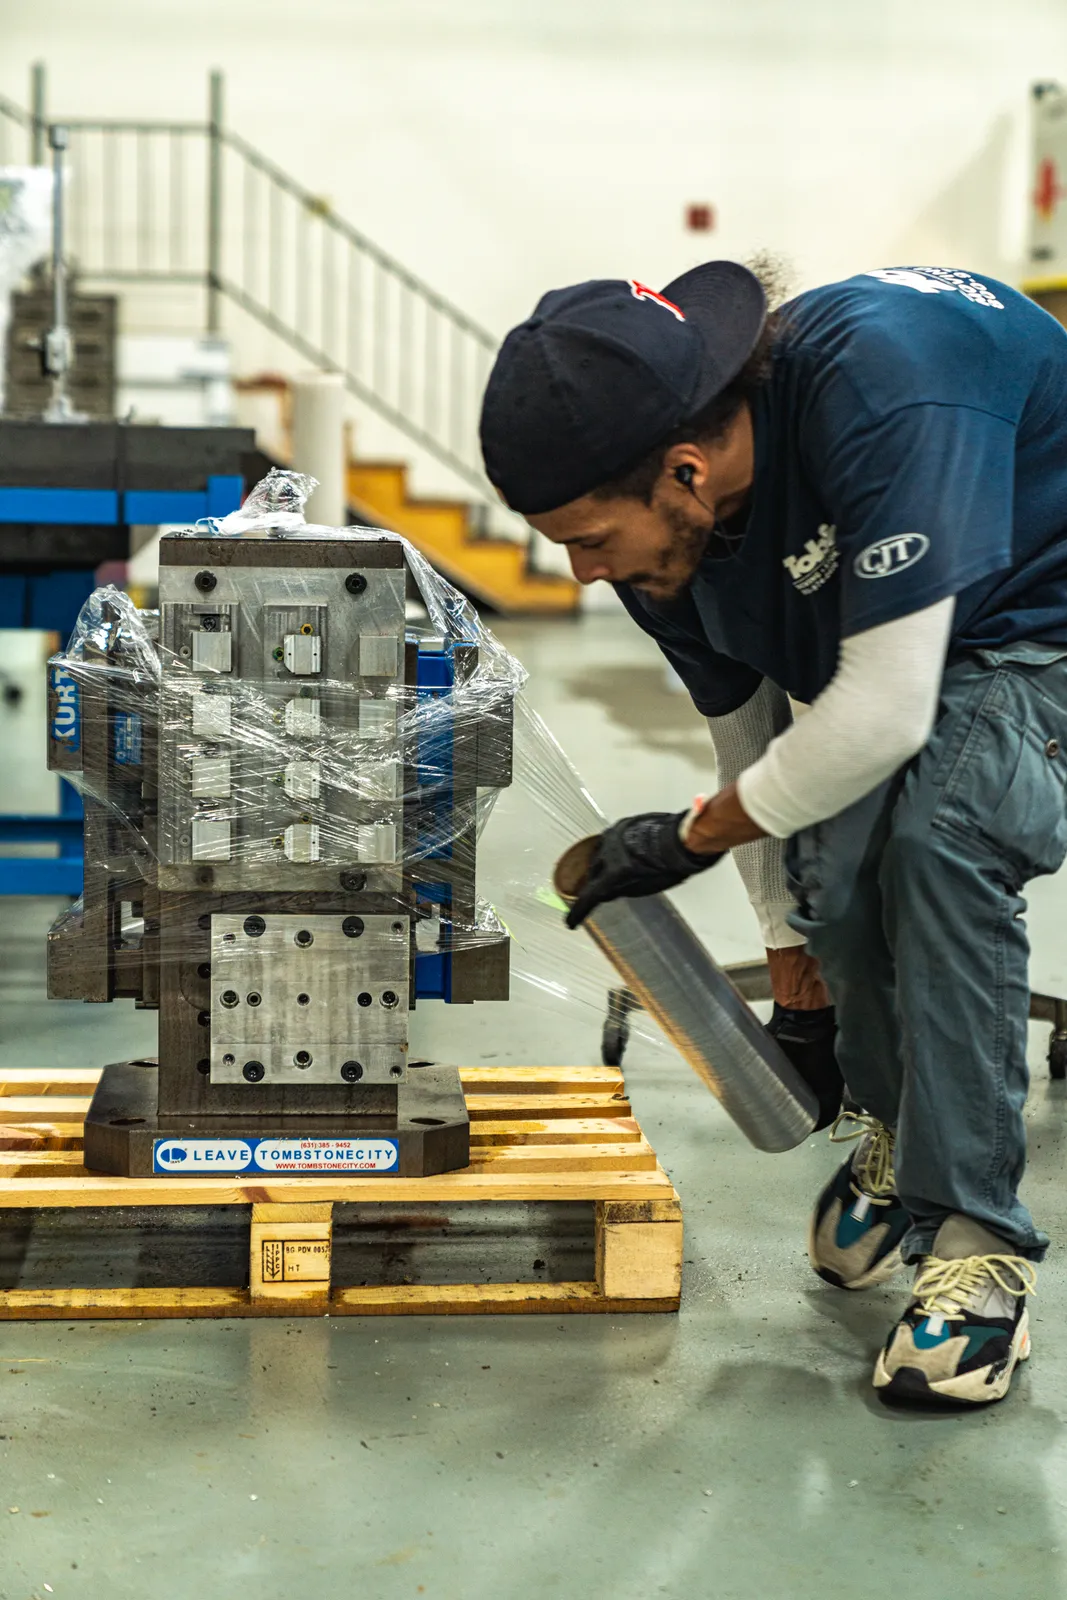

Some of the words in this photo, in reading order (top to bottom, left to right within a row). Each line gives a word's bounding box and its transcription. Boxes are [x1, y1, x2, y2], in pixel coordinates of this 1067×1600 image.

[862, 537, 914, 575] CJT
[54, 668, 76, 738] KURT
[193, 1150, 249, 1161] LEAVE
[260, 1150, 393, 1160] TOMBSTONECITY
